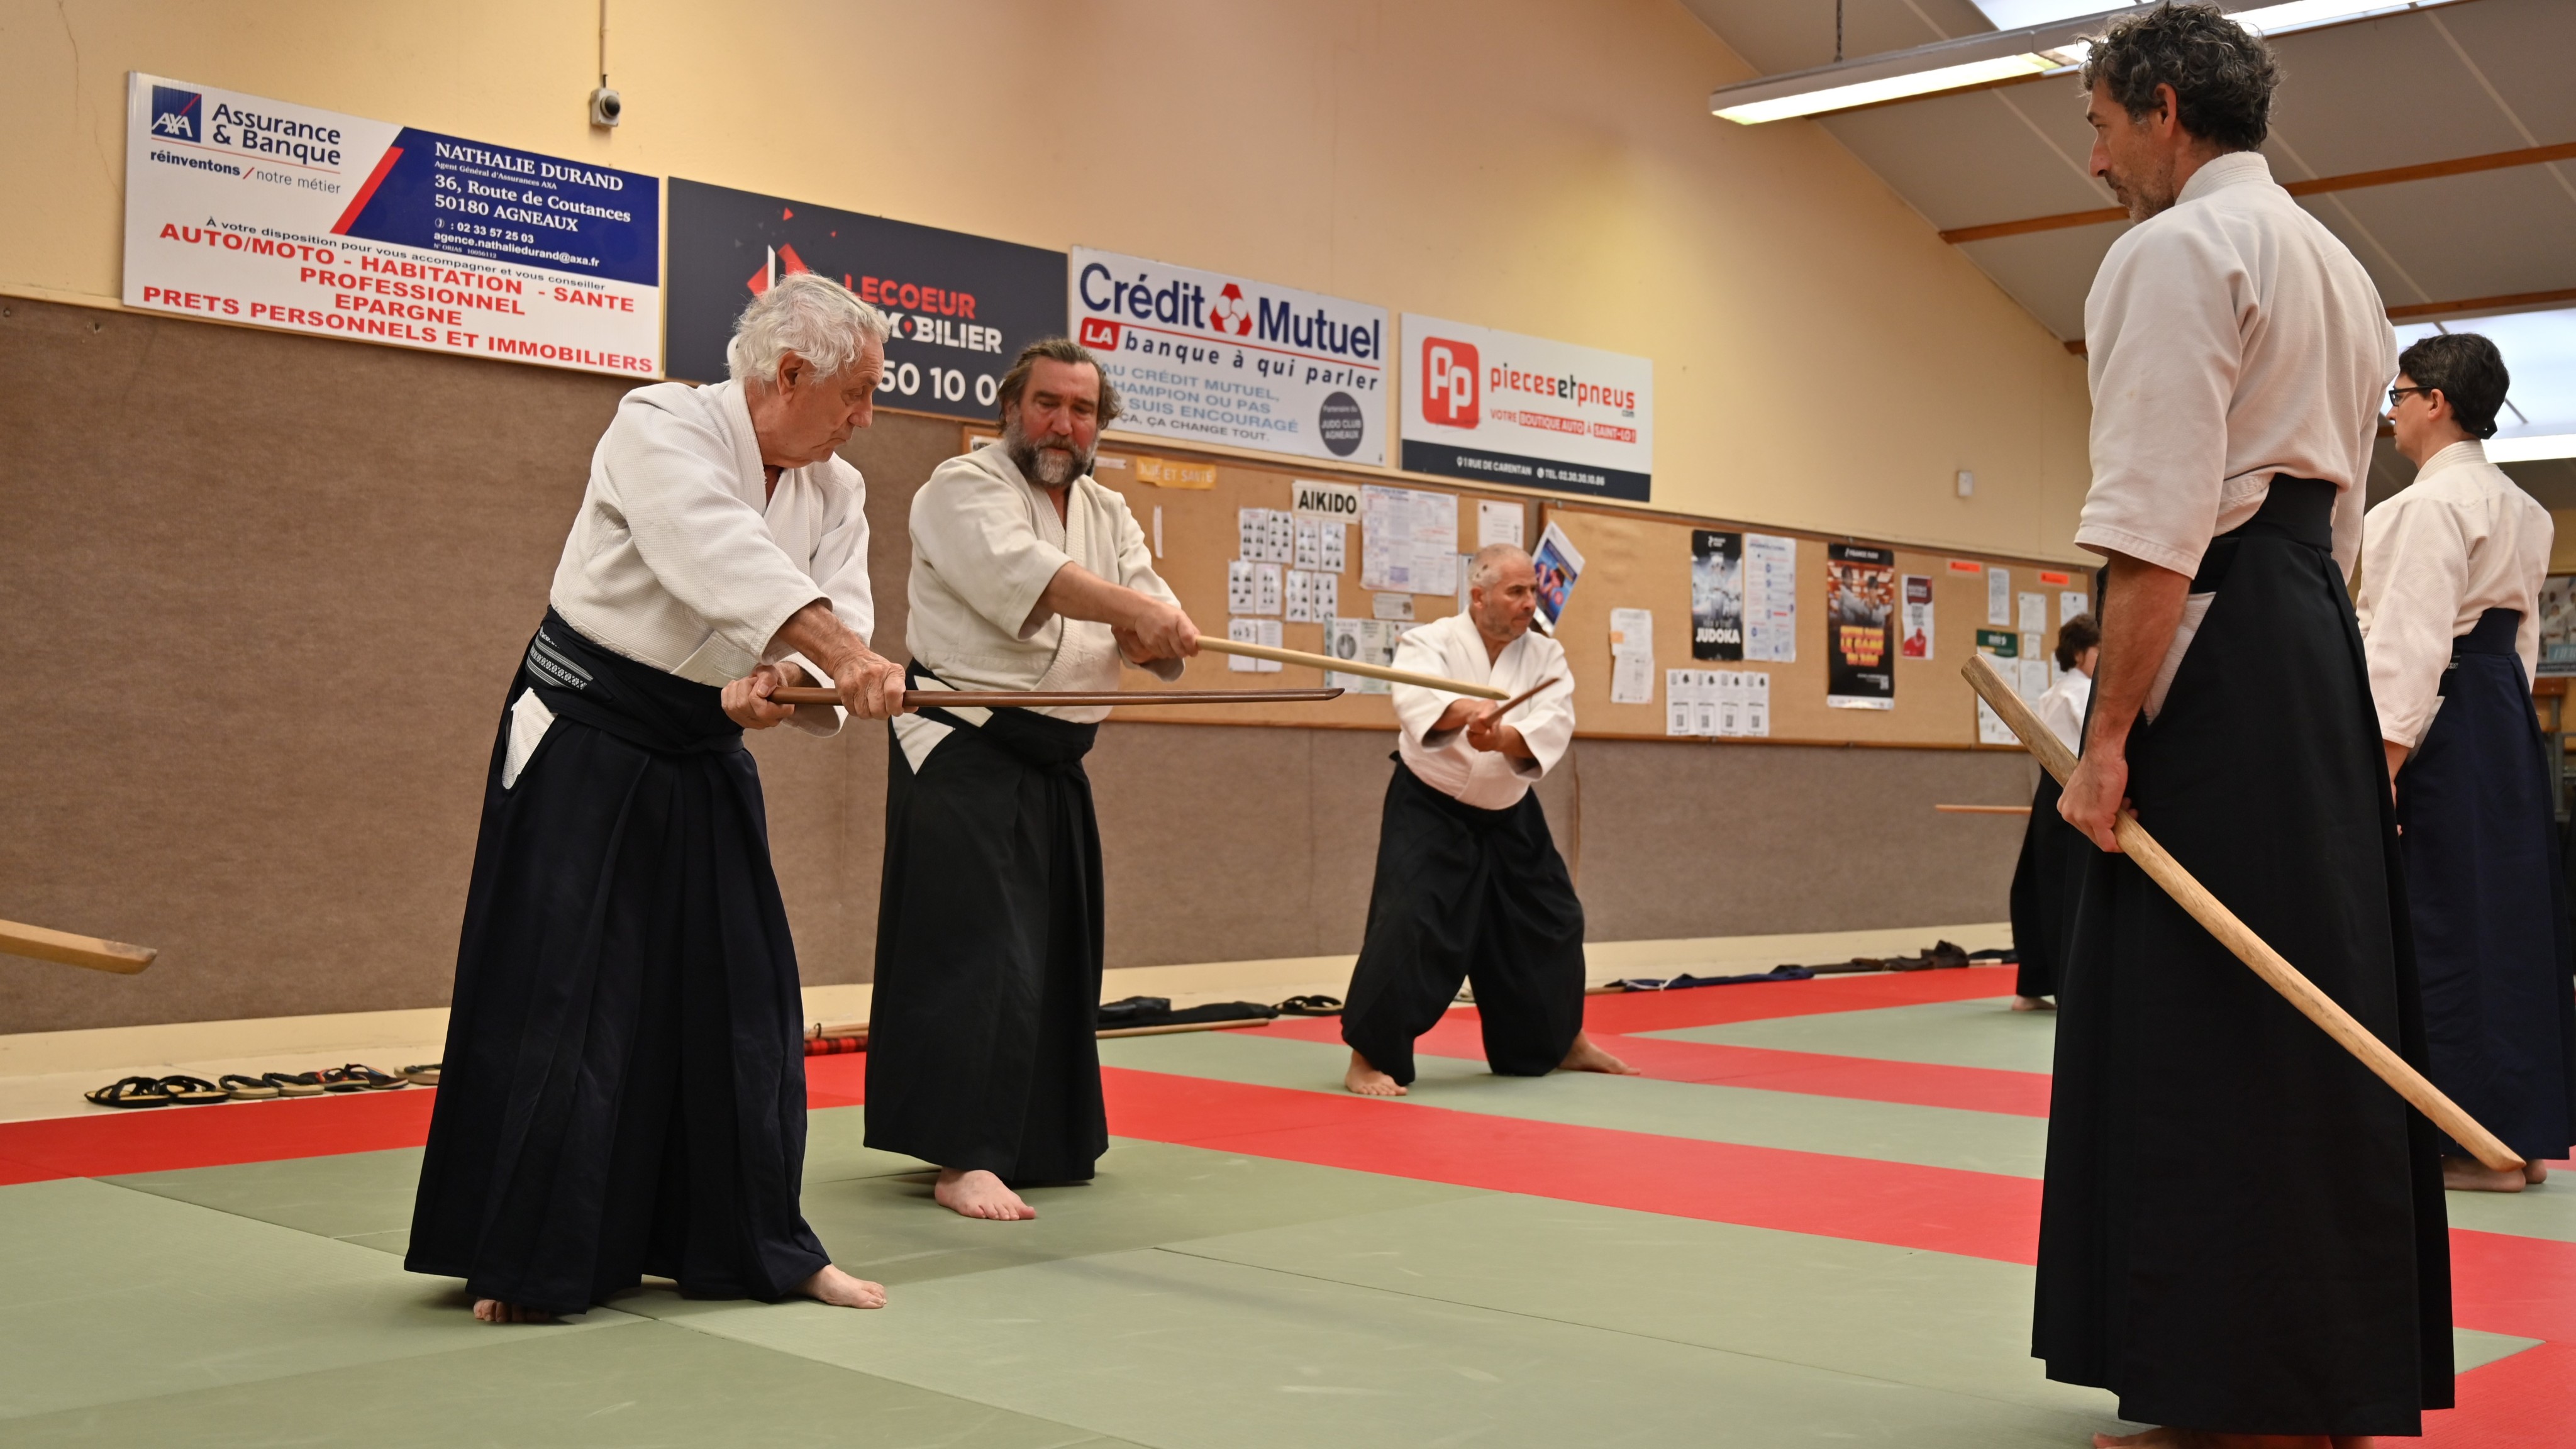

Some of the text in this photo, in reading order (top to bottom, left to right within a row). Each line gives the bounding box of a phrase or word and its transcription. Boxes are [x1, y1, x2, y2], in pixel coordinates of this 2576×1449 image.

[152, 112, 192, 138] AXA
[212, 103, 340, 145] Assurance
[213, 125, 340, 165] & Banque
[151, 150, 240, 176] réinventons
[256, 169, 292, 186] notre
[297, 177, 340, 194] métier
[434, 160, 557, 190] Agent Général d'Assurances AXA
[435, 142, 623, 191] NATHALIE DURAND
[435, 174, 631, 222] 36, Route de Coutances
[435, 194, 579, 232] 50180 AGNEAUX
[434, 232, 600, 267] agence.nathaliedurand@axa.fr
[457, 222, 470, 233] 02
[474, 225, 487, 235] 33
[489, 228, 502, 238] 57
[505, 231, 519, 241] 25
[521, 234, 534, 243] 03
[159, 223, 335, 265] AUTO/MOTO
[361, 256, 522, 295] HABITATION
[554, 287, 634, 313] SANTE
[206, 216, 606, 291] À votre disposition pour vous accompagner et vous conseiller
[300, 267, 526, 315] PROFESSIONNEL
[335, 294, 462, 326] EPARGNE
[845, 274, 975, 319] LECOEUR
[143, 286, 653, 372] PRETS PERSONNELS ET IMMOBILIERS
[1080, 262, 1380, 360] Crédit Mutuel
[1085, 324, 1378, 391] LA banque à qui parler
[877, 360, 1005, 406] 50 10 0
[1101, 363, 1280, 402] AU CRÉDIT MUTUEL,
[1112, 380, 1271, 414] HAMPION OU PAS
[1128, 398, 1299, 433] SUIS ENCOURAGÉ
[1147, 416, 1166, 428] ÇA
[1170, 419, 1228, 435] CHANGE
[1233, 428, 1270, 441] TOUT.
[1321, 419, 1362, 429] JUDO CLUB
[1325, 430, 1359, 439] AGNEAUX
[1490, 408, 1517, 423] VOTRE
[1520, 412, 1560, 430] BOUTIQUE
[1562, 418, 1584, 434] AUTO
[1468, 458, 1482, 469] RUE
[1483, 460, 1492, 471] DE
[1493, 461, 1532, 476] CARENTAN
[1298, 489, 1357, 514] AIKIDO
[1696, 627, 1741, 644] JUDOKA
